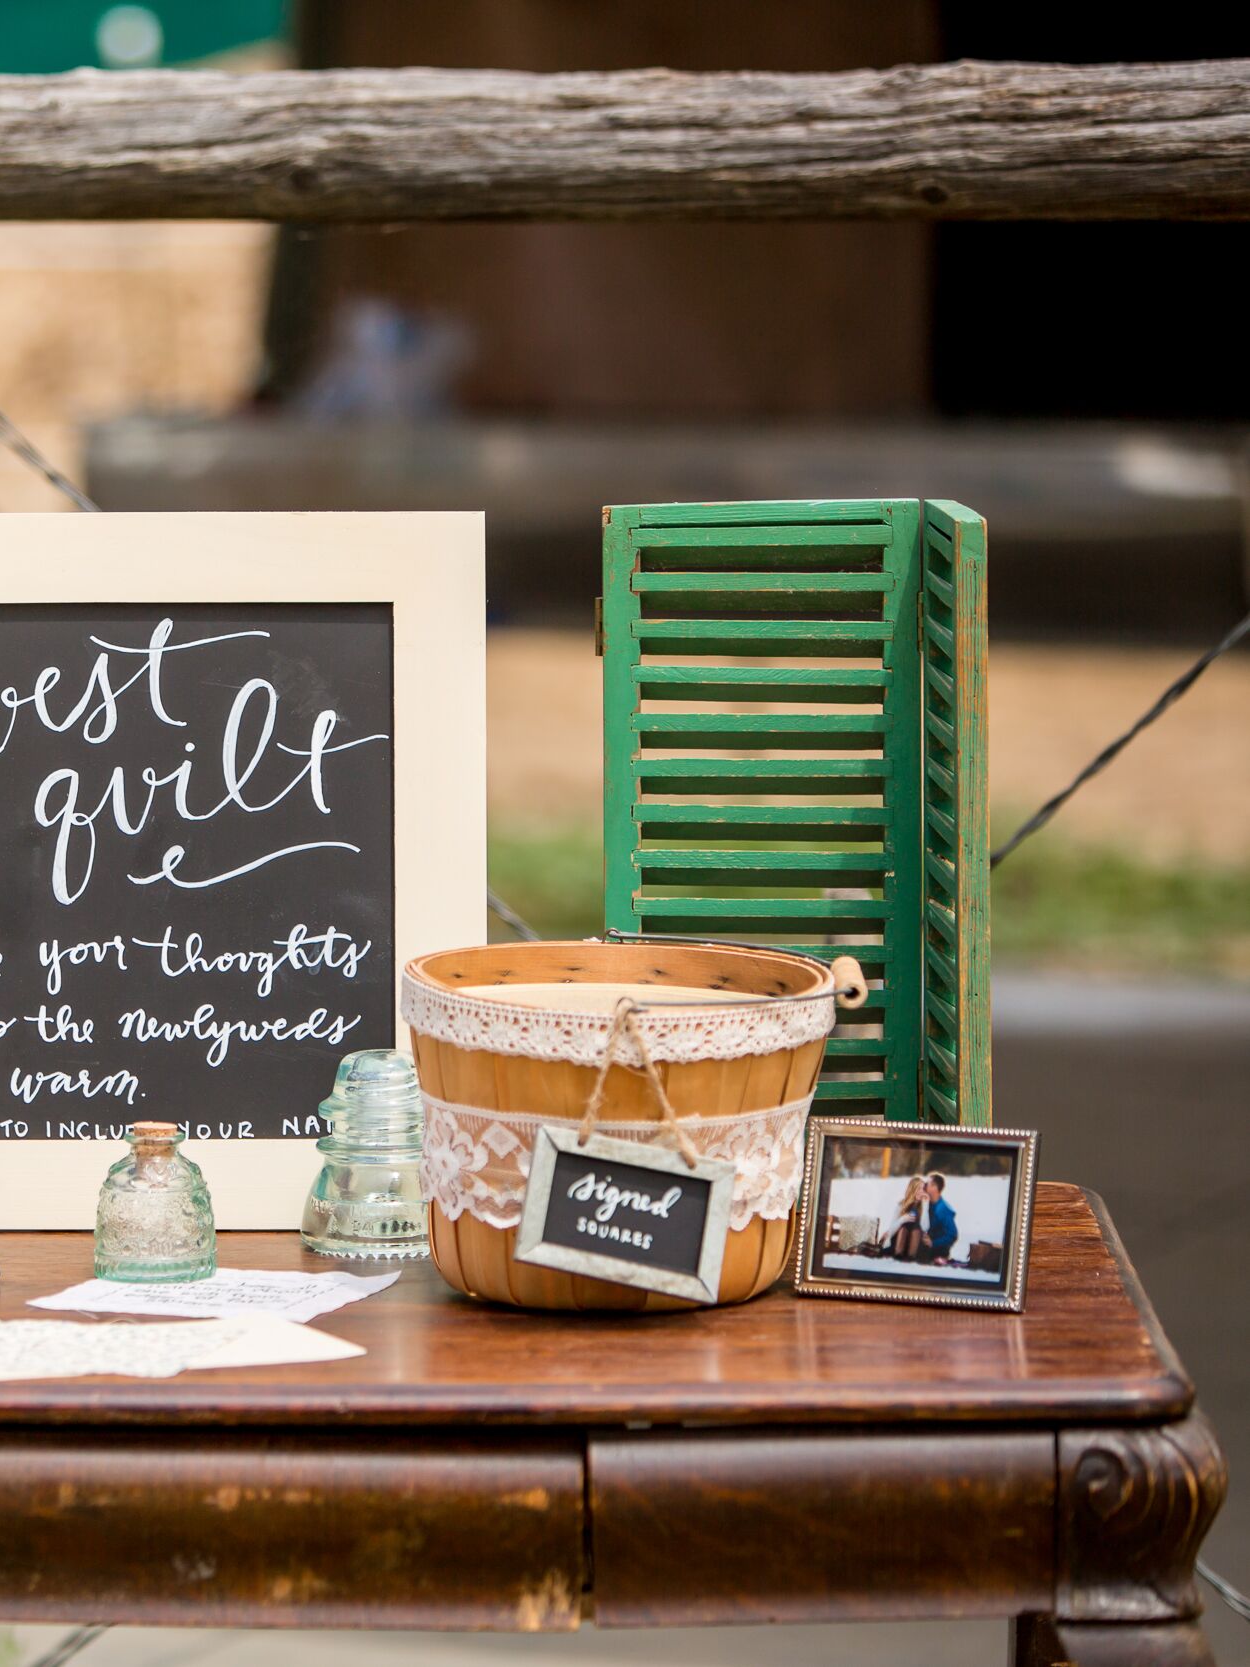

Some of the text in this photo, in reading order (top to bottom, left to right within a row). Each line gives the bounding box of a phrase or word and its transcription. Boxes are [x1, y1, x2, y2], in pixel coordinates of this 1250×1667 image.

[35, 678, 389, 905] quilt
[39, 936, 128, 995] your
[132, 924, 372, 997] thoughts
[24, 1005, 94, 1044] the
[10, 1067, 147, 1105] warm.
[0, 1120, 31, 1139] TO
[177, 1119, 255, 1140] YOUR
[566, 1172, 683, 1223] signed
[576, 1216, 654, 1251] SQUARES
